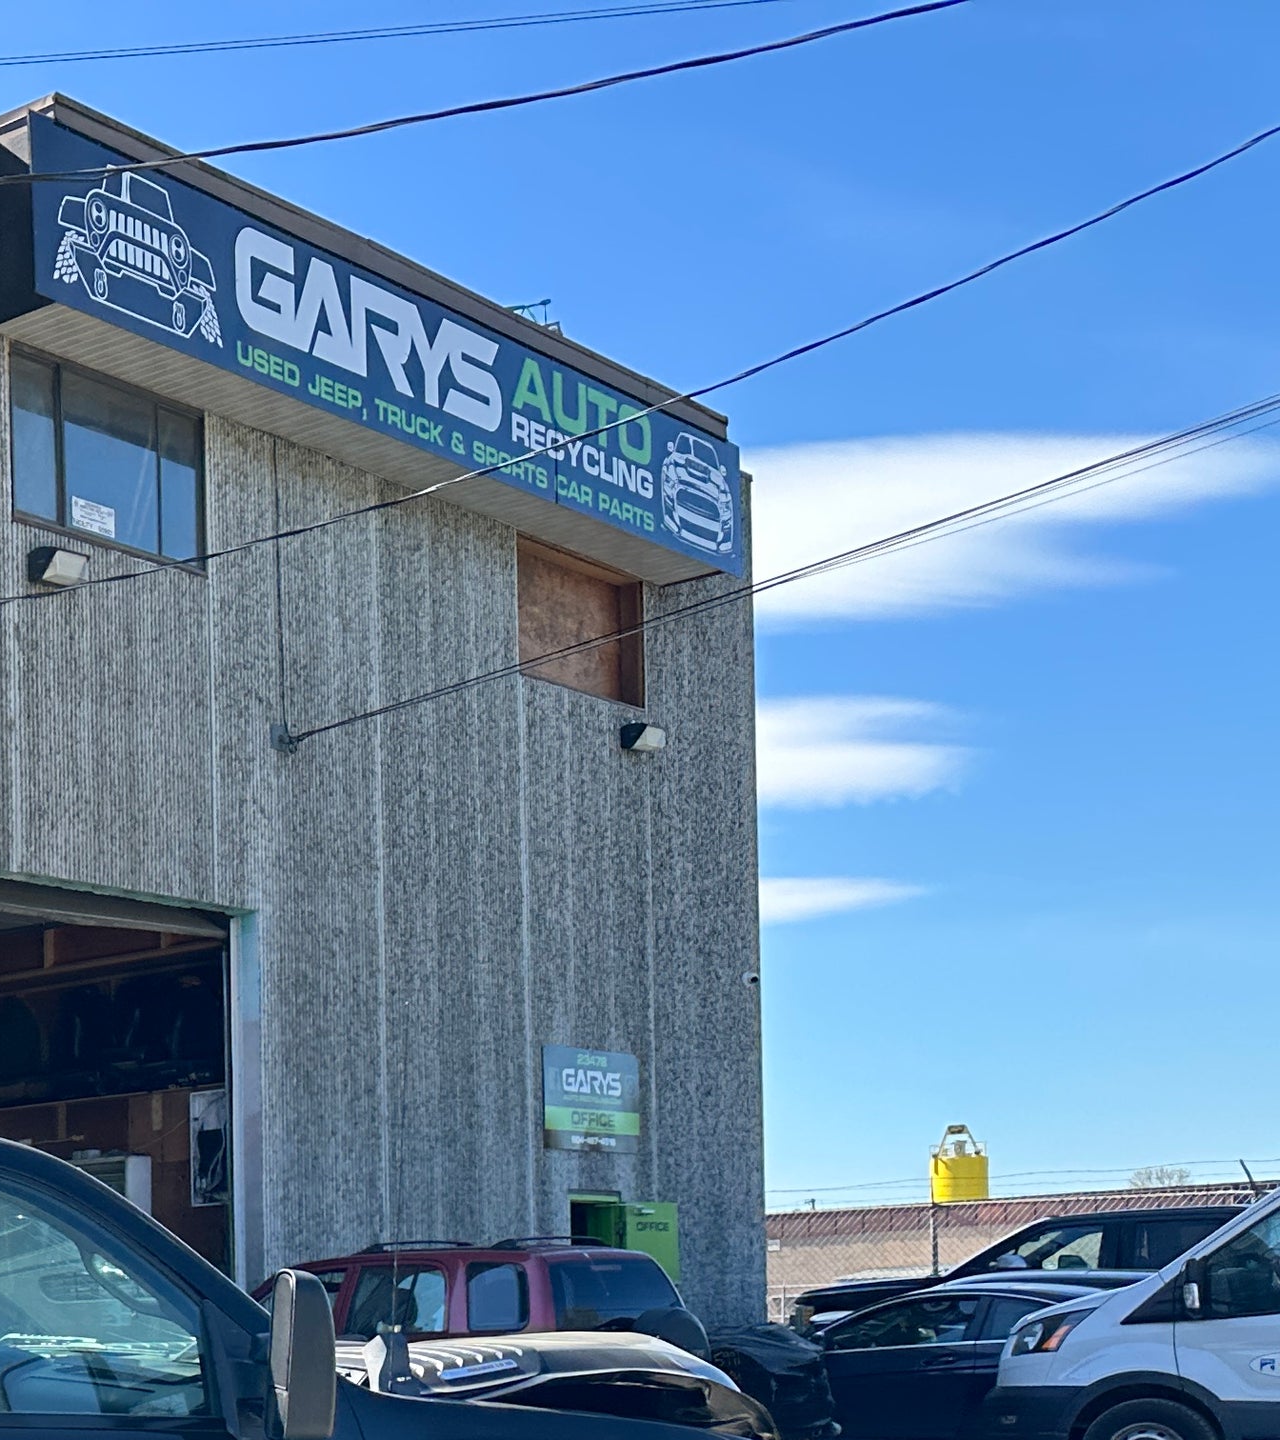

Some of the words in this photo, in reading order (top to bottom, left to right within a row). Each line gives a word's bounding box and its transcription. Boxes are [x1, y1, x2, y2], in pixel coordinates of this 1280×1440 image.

[235, 227, 502, 432] GARYS
[512, 357, 652, 465] AUTO
[236, 341, 300, 387] USED
[308, 374, 367, 420] JEEP,
[375, 398, 444, 447] TRUCK
[451, 431, 465, 455] &
[473, 440, 548, 488] SPORTS
[554, 474, 592, 507] CAR
[599, 492, 655, 532] PARTS
[511, 412, 654, 499] RECYCLING
[562, 1068, 622, 1097] GARYS
[571, 1110, 616, 1128] OFFICE
[636, 1221, 670, 1232] OFFICE
